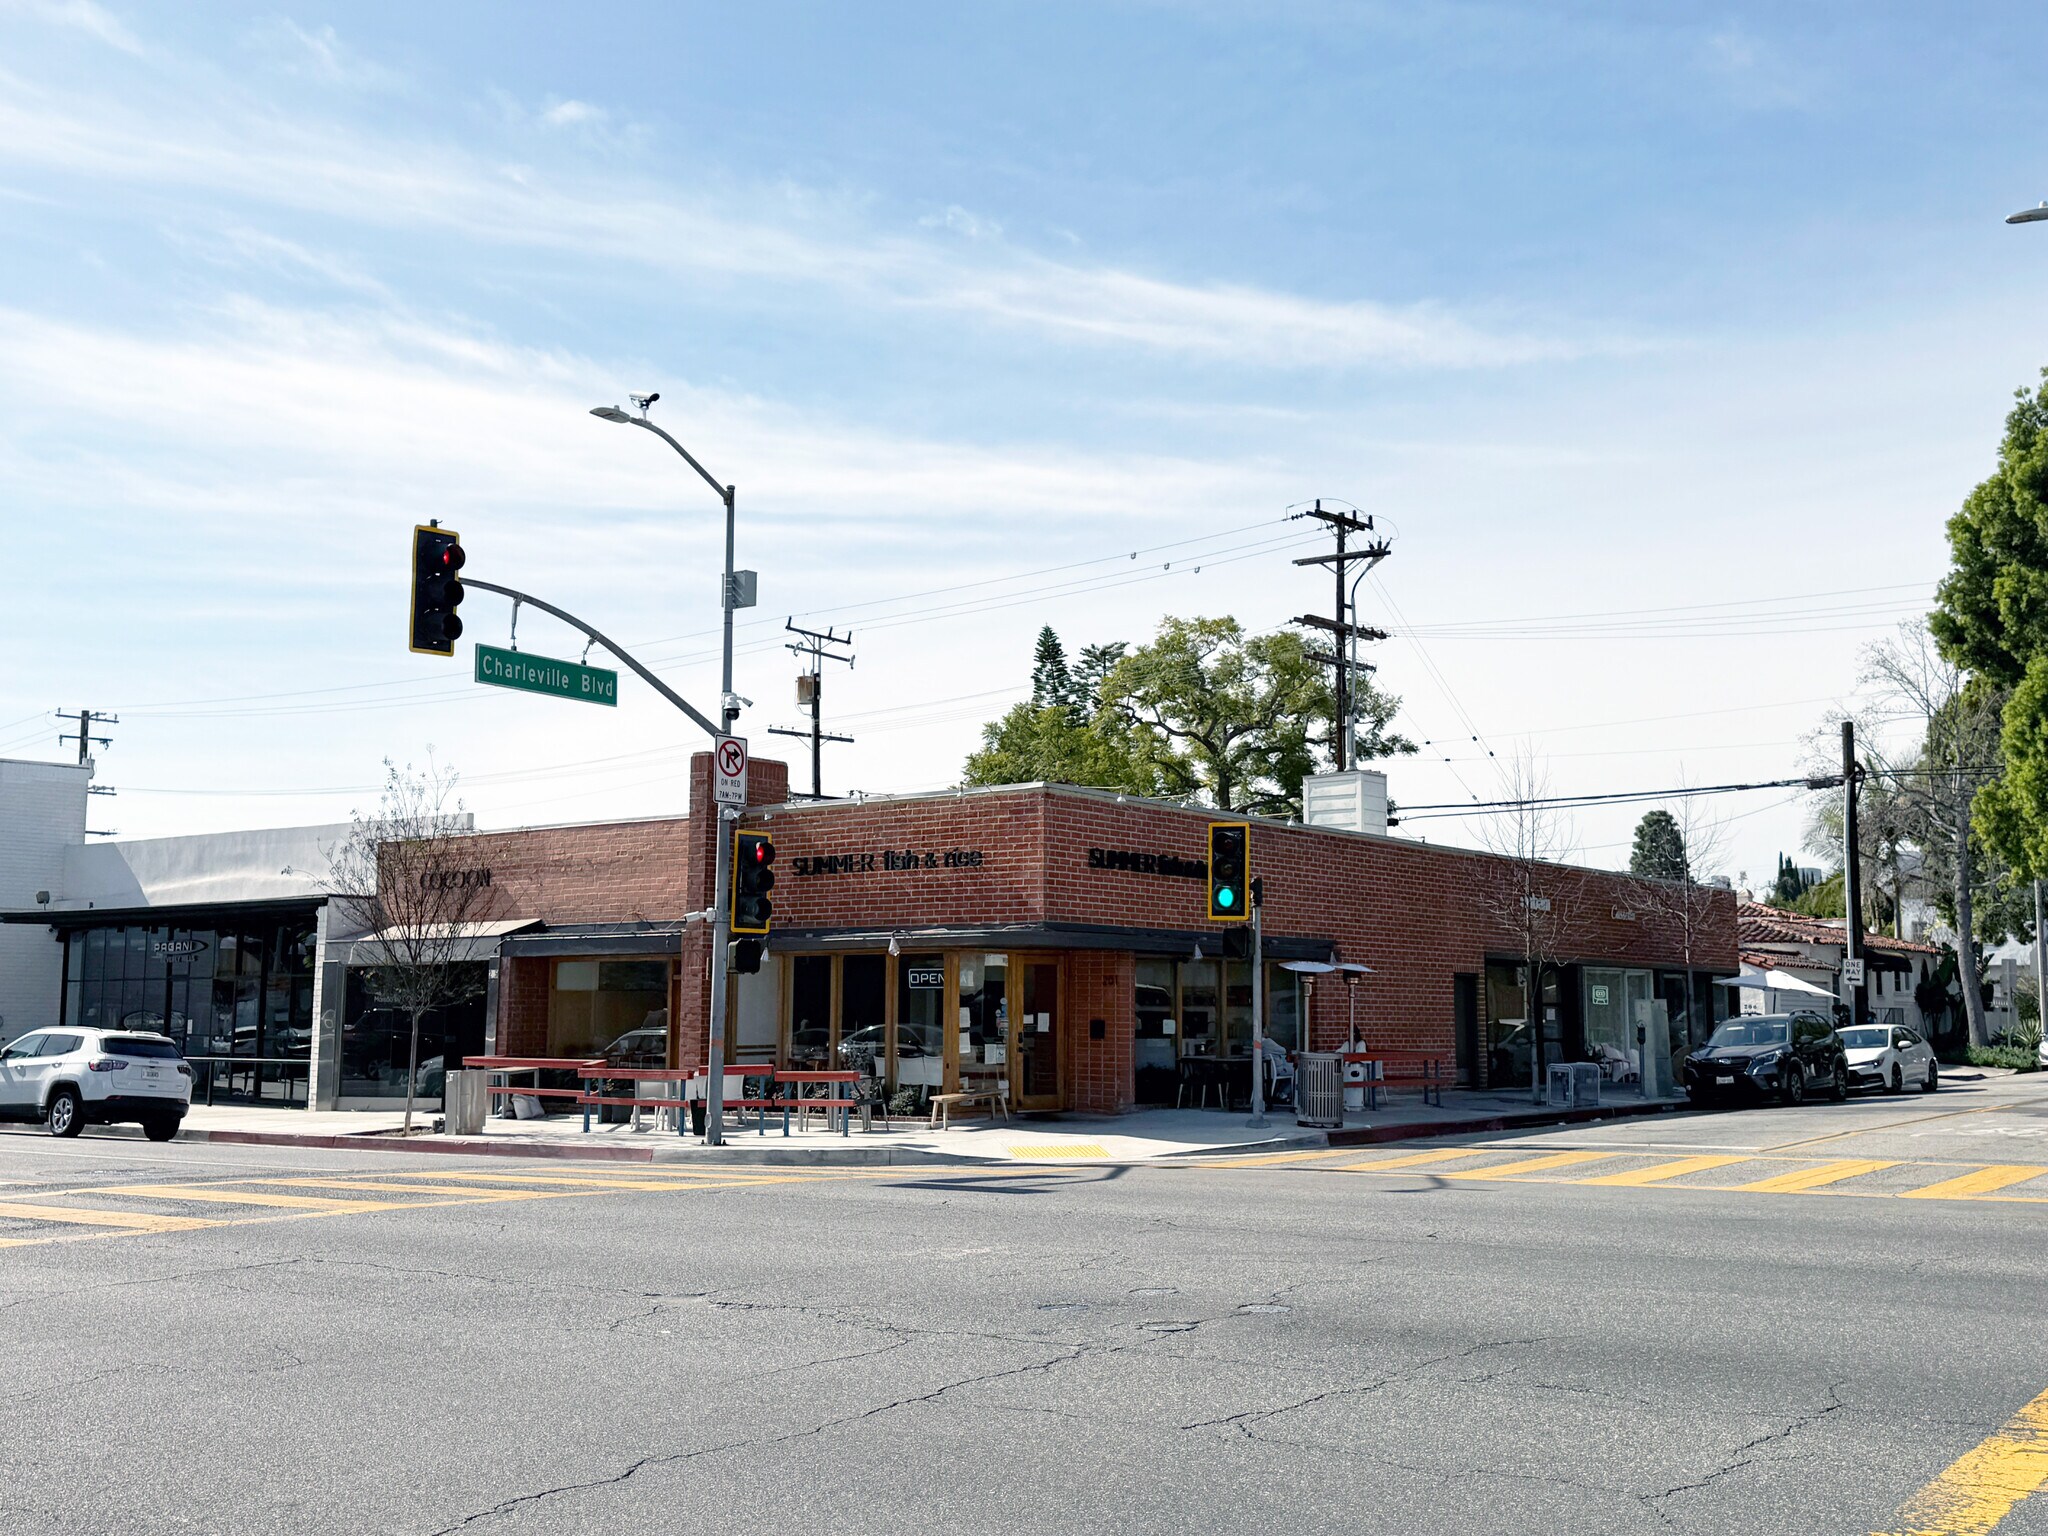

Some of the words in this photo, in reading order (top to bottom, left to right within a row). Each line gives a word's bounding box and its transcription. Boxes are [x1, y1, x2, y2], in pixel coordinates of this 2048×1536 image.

[482, 655, 570, 689] Charleville
[581, 674, 613, 697] Blvd
[720, 778, 729, 786] ON
[730, 779, 741, 788] RED
[792, 852, 875, 877] SUMMER
[883, 849, 919, 871] fish
[924, 850, 938, 869] &
[943, 847, 983, 868] rice
[1088, 848, 1157, 874] SUMMER
[153, 942, 193, 953] PAGANI
[910, 973, 945, 984] OPEN
